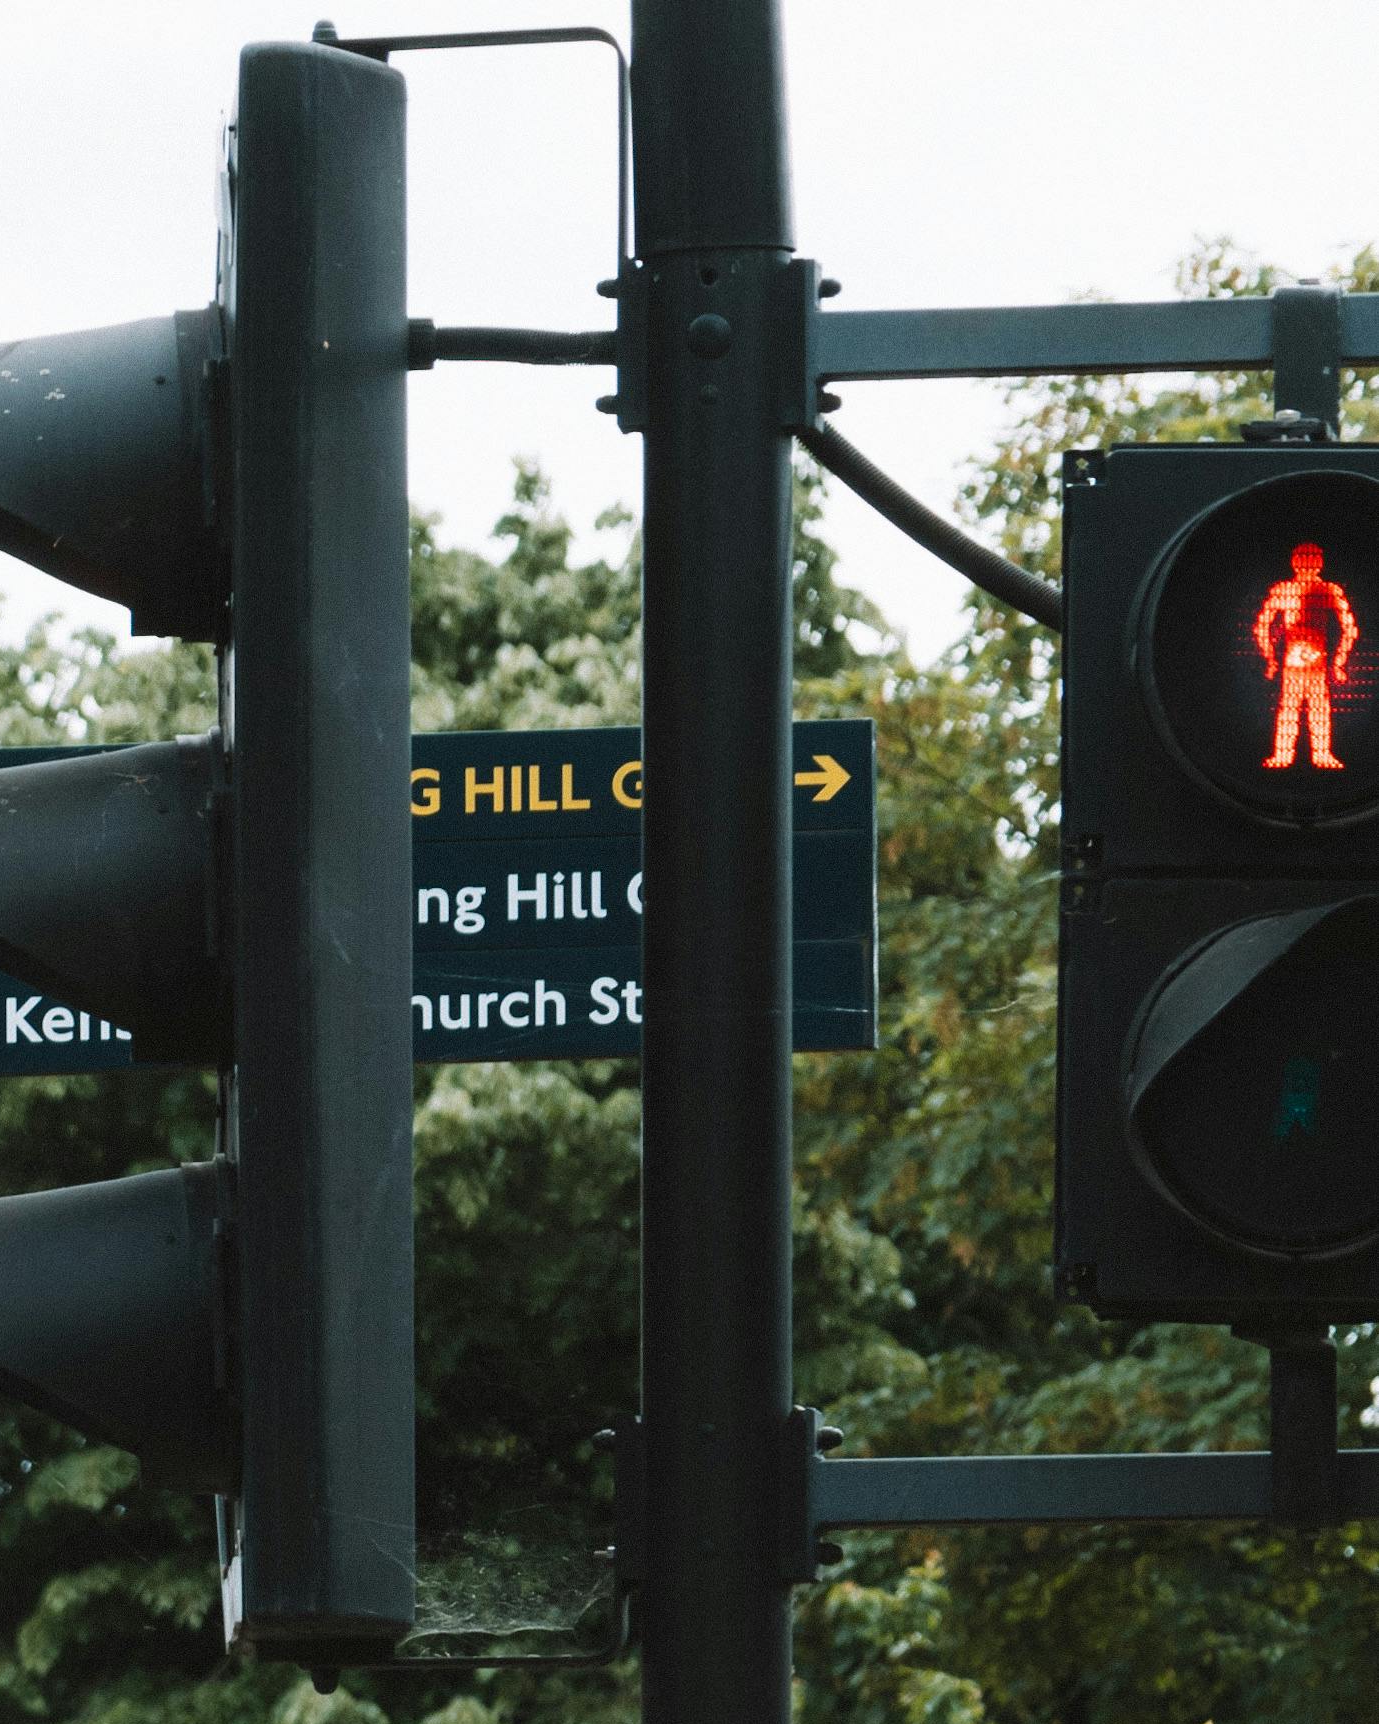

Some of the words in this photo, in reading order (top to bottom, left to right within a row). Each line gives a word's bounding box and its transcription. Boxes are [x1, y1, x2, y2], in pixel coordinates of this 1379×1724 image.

[410, 768, 440, 815] G
[465, 765, 590, 813] HILL
[613, 761, 642, 808] G
[419, 887, 486, 934] ng
[508, 871, 607, 920] Hill
[6, 996, 131, 1043] Ken
[589, 977, 642, 1024] St
